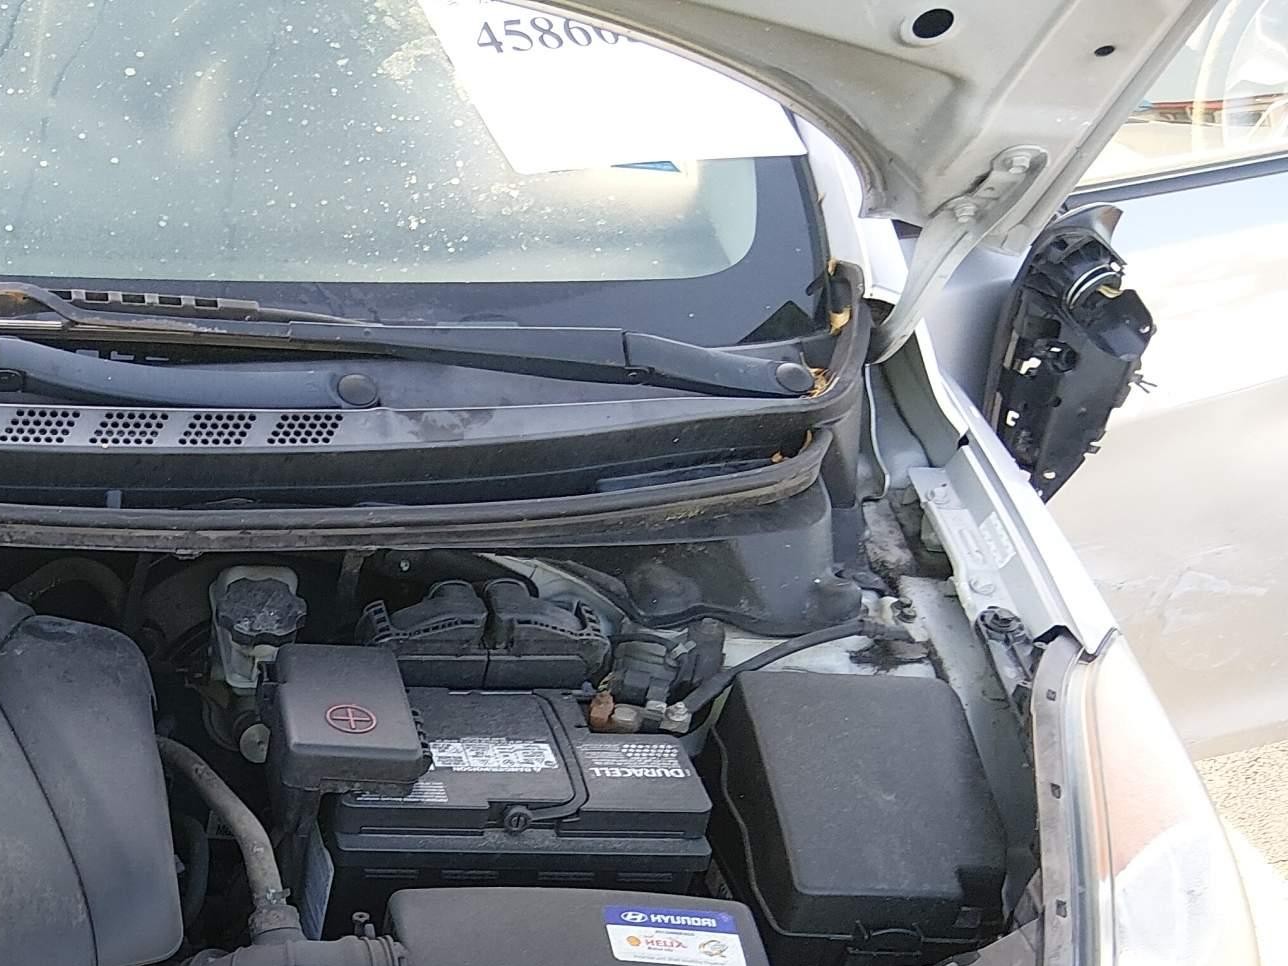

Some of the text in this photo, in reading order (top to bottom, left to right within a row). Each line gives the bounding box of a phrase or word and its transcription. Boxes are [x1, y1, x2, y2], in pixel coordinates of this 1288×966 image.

[588, 767, 686, 778] DURACELL
[649, 914, 717, 928] HYUNDAI
[645, 939, 688, 949] HELIX
